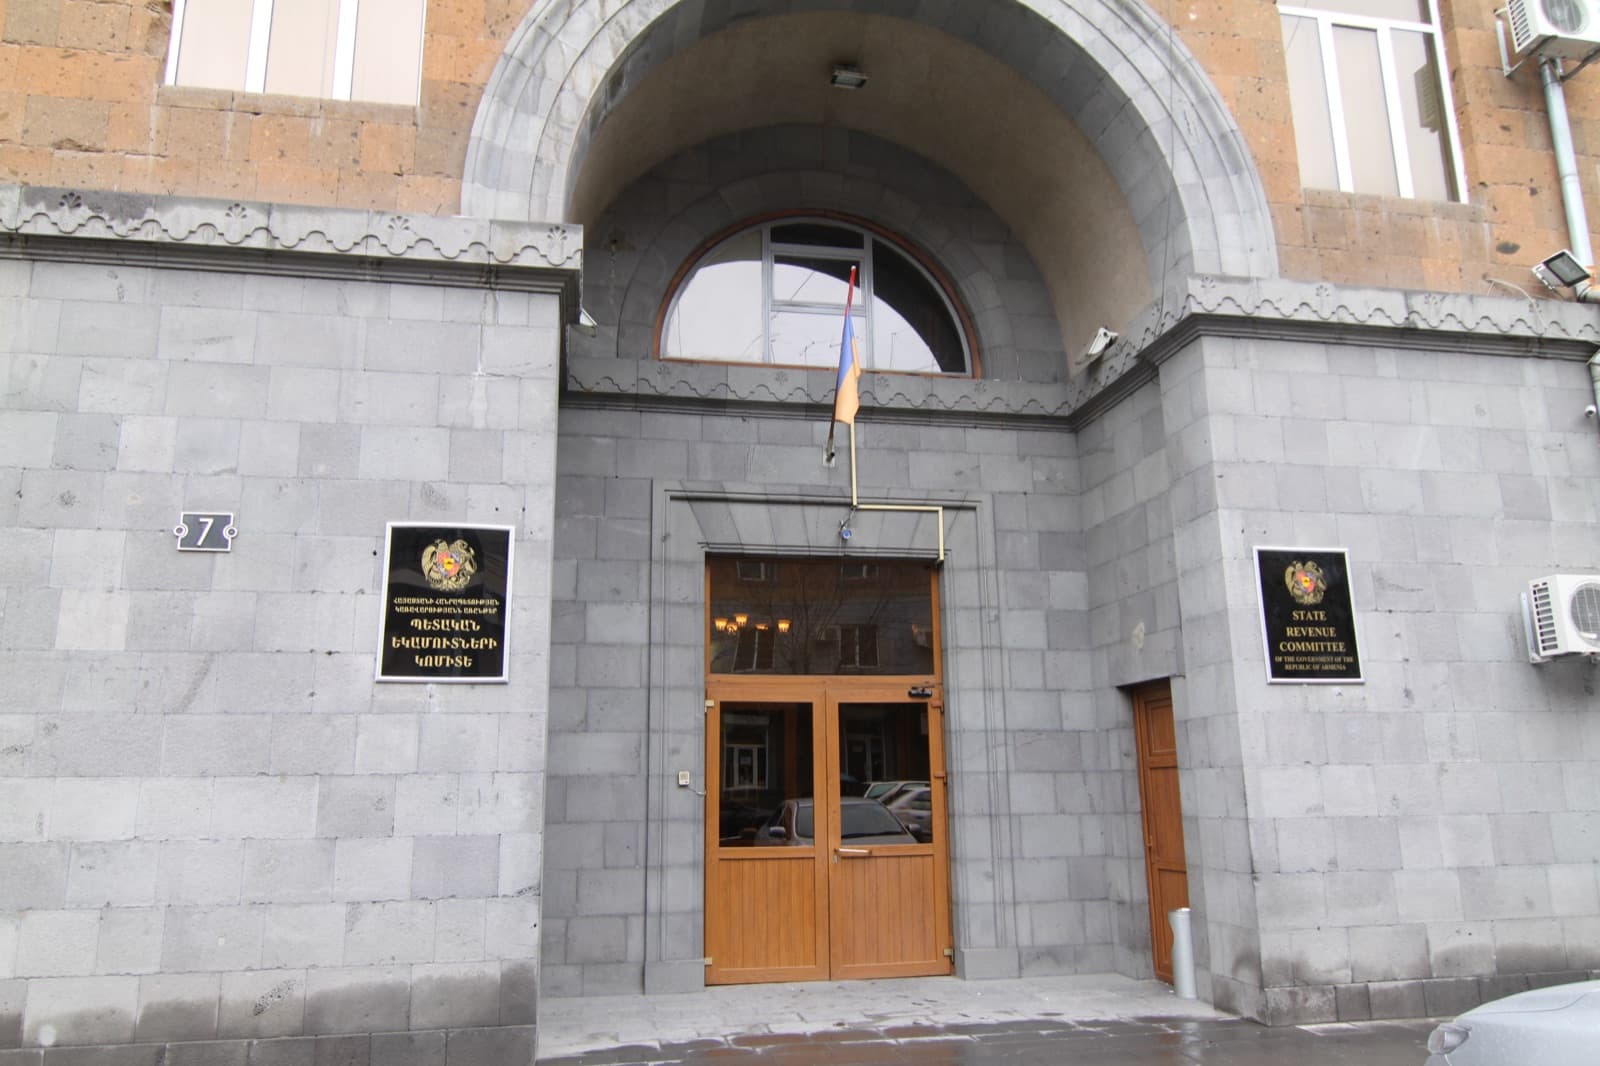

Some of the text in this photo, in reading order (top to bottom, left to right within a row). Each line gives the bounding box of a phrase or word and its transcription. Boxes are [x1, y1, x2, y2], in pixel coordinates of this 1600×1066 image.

[196, 518, 214, 546] 7
[1292, 610, 1327, 621] STATE
[410, 618, 480, 631] ՊԵՏԱԿԱՆ
[1286, 627, 1336, 637] REVENUE
[392, 636, 497, 650] ԵԿԱՄՈՒՏՆԵՐԻ
[1279, 641, 1346, 652] COMMITTEE
[415, 655, 472, 667] ԿՈՄԻՏԵ
